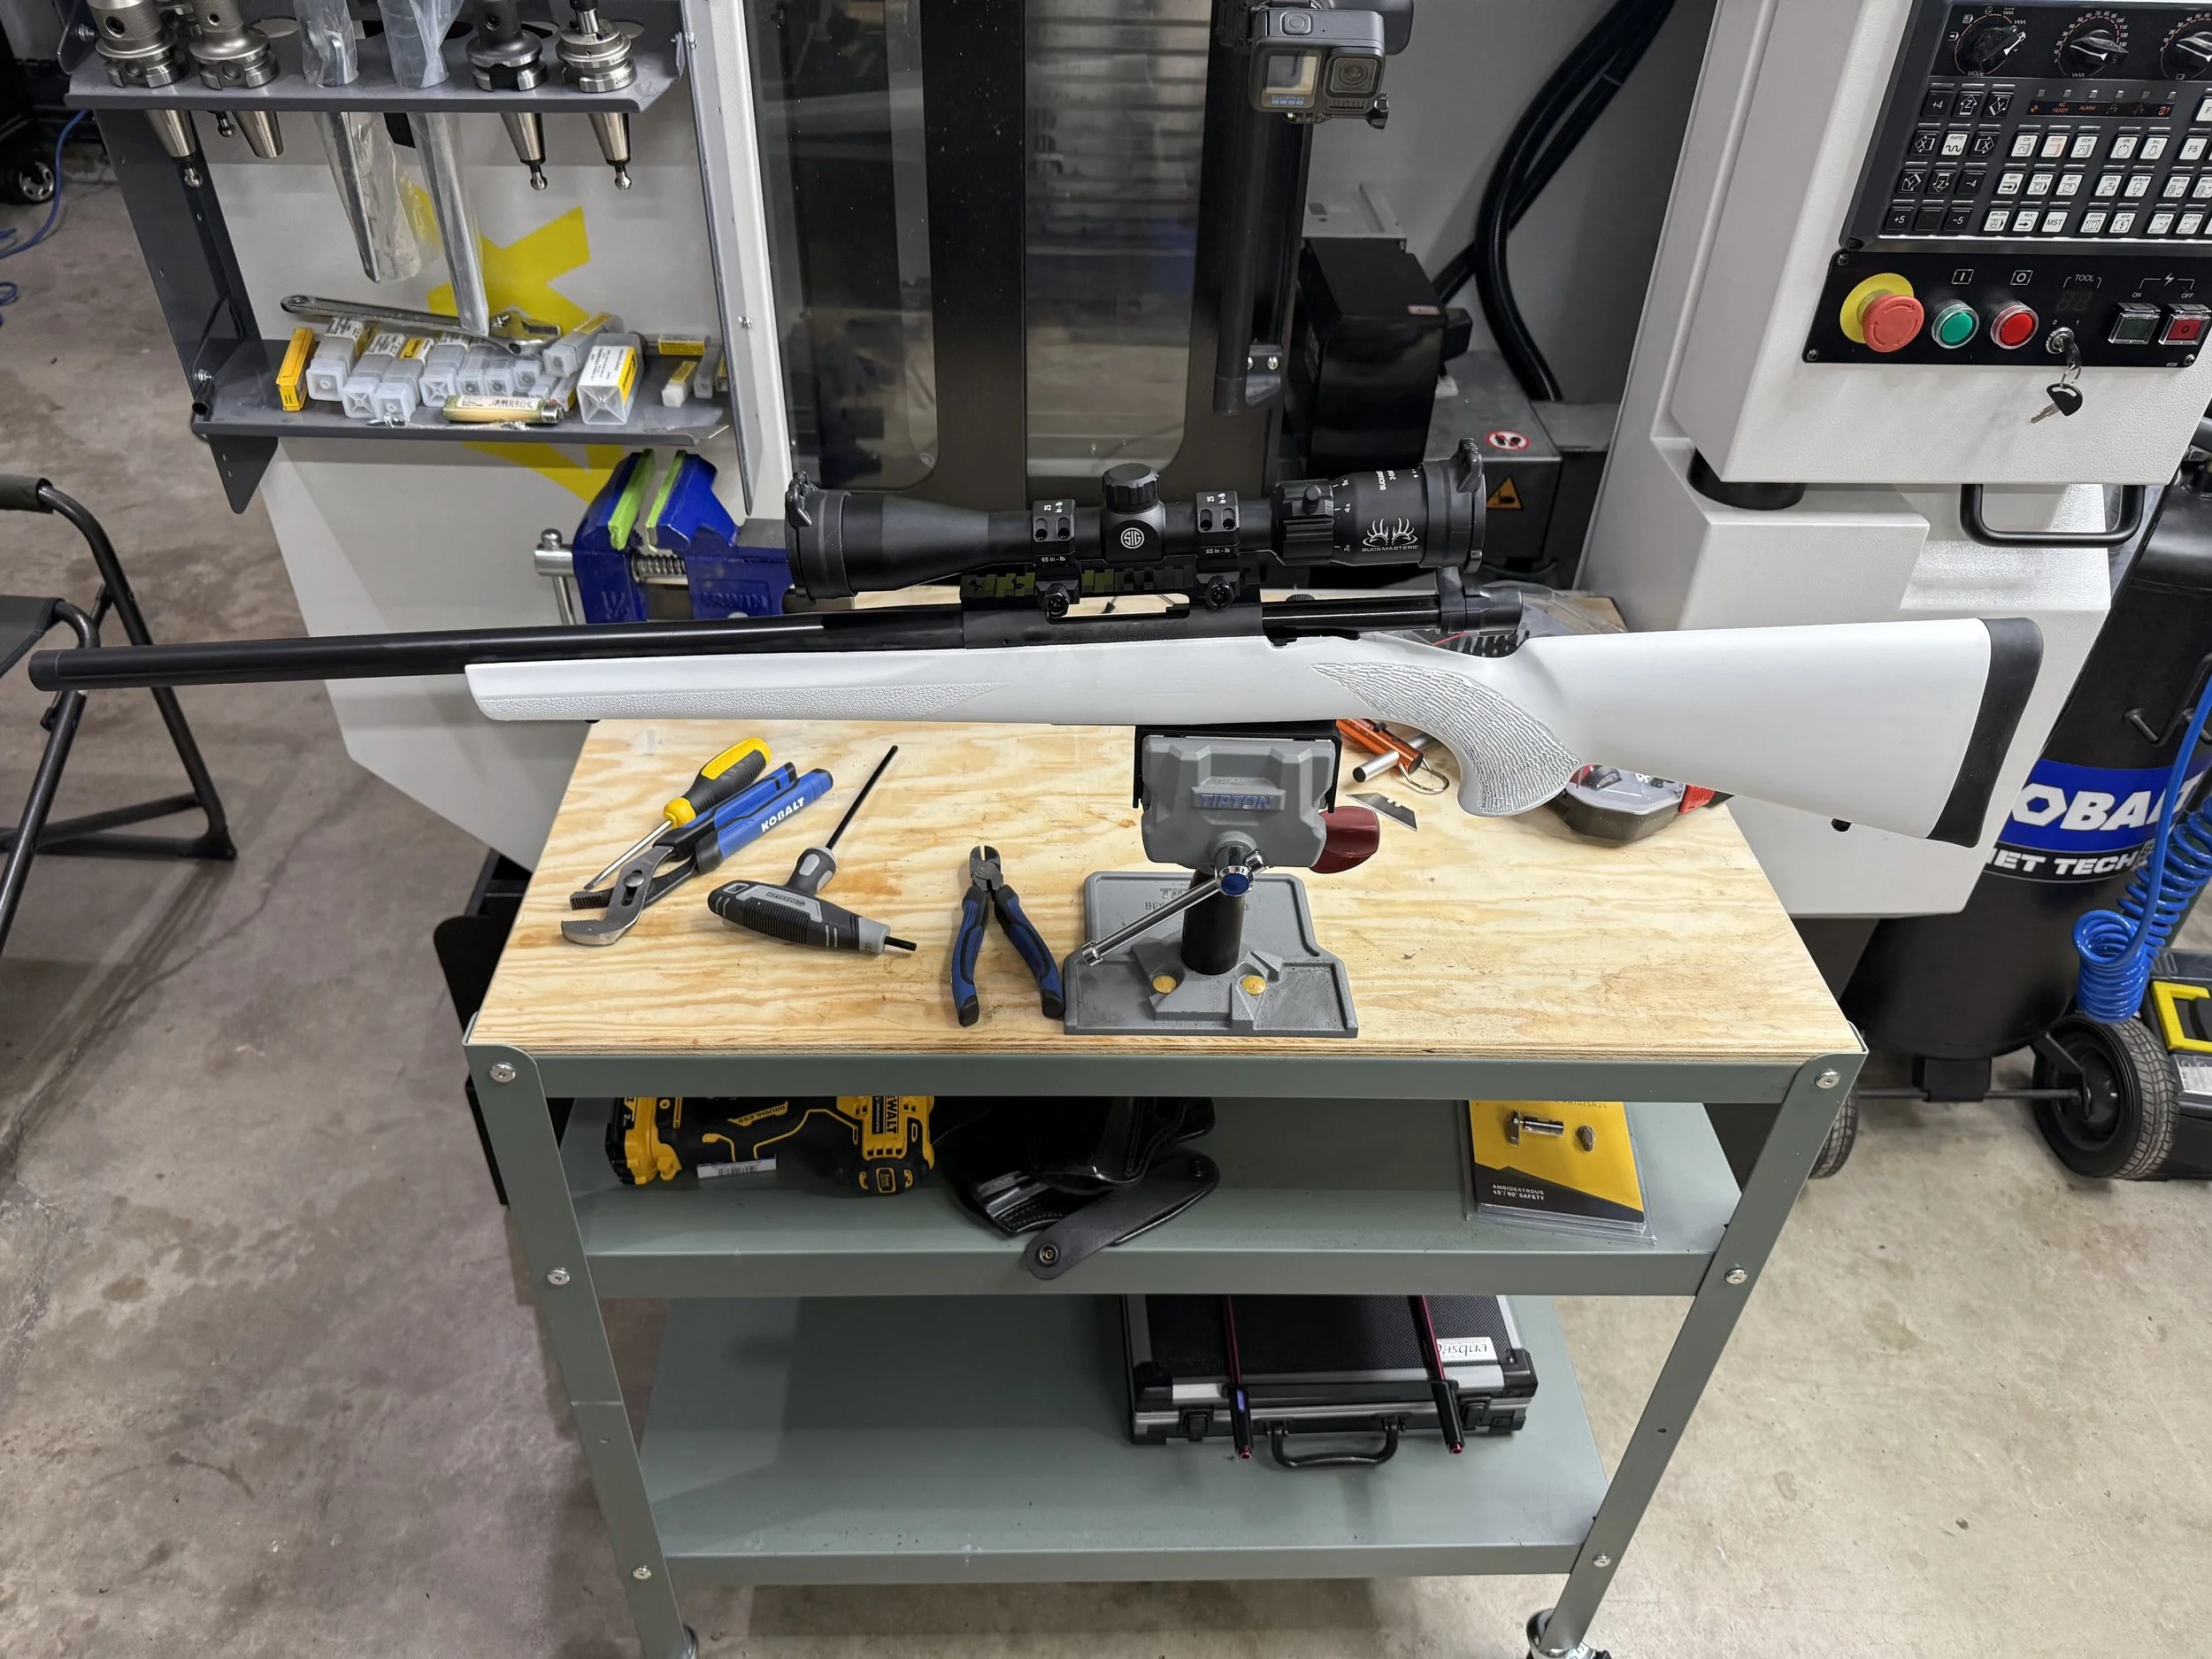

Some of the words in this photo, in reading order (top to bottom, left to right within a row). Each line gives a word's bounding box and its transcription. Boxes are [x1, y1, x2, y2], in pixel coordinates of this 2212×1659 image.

[1932, 100, 1944, 109] +4
[1964, 99, 1973, 109] Z
[1997, 101, 2005, 111] Y
[1918, 140, 1927, 149] X
[1983, 141, 1991, 150] X
[1907, 180, 1914, 188] Y
[1936, 180, 1946, 188] Z
[1893, 215, 1905, 224] +5
[1953, 216, 1963, 225] -5
[1344, 503, 1351, 512] 4x
[1123, 530, 1142, 547] SIG
[1202, 794, 1274, 810] TIPTON
[761, 797, 804, 833] KOBALT
[2054, 849, 2140, 876] TECH
[738, 1104, 786, 1124] BRUSHLESS
[1492, 1184, 1544, 1194] AMBIDEXTROUS
[1518, 1192, 1545, 1201] SAFETY
